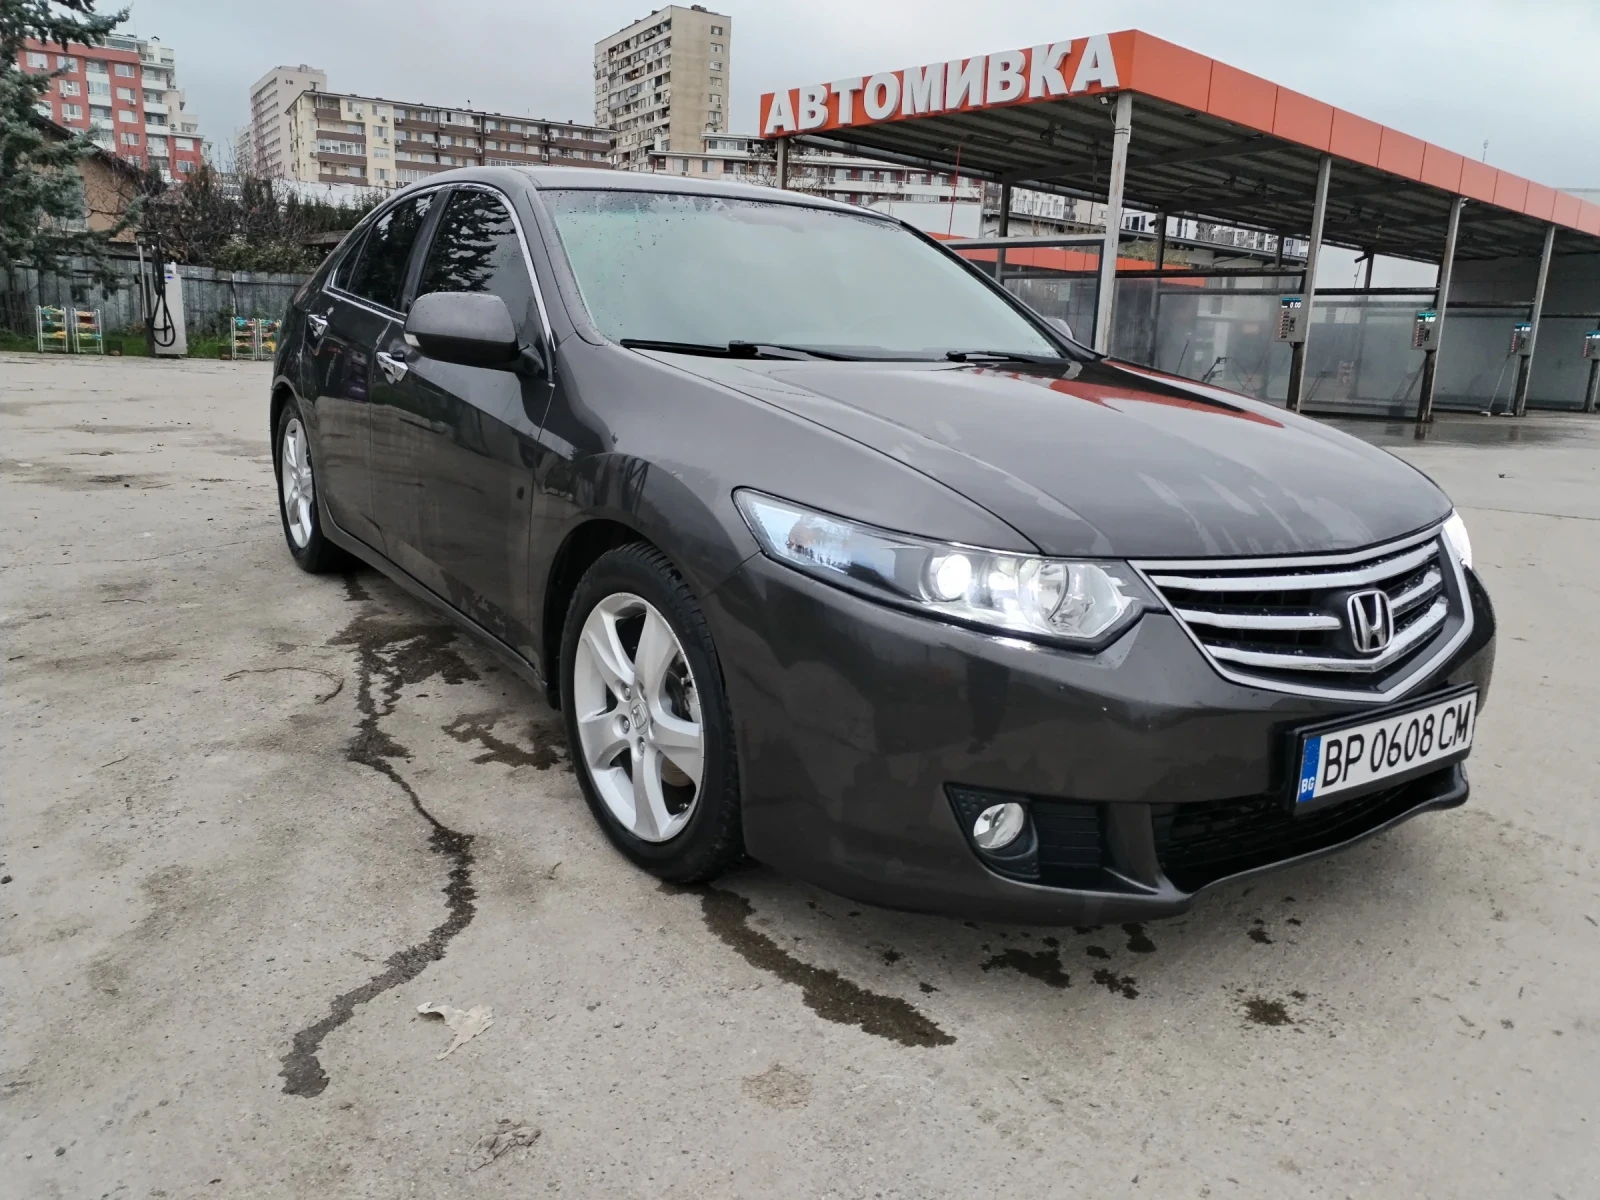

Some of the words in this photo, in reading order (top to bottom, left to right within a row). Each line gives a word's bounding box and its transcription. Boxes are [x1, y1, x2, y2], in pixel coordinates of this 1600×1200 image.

[764, 34, 1119, 134] АВТОМИВКА
[1301, 776, 1315, 793] BG
[1322, 734, 1364, 788] BP
[1370, 713, 1434, 773] 0608
[1438, 700, 1471, 750] CM
